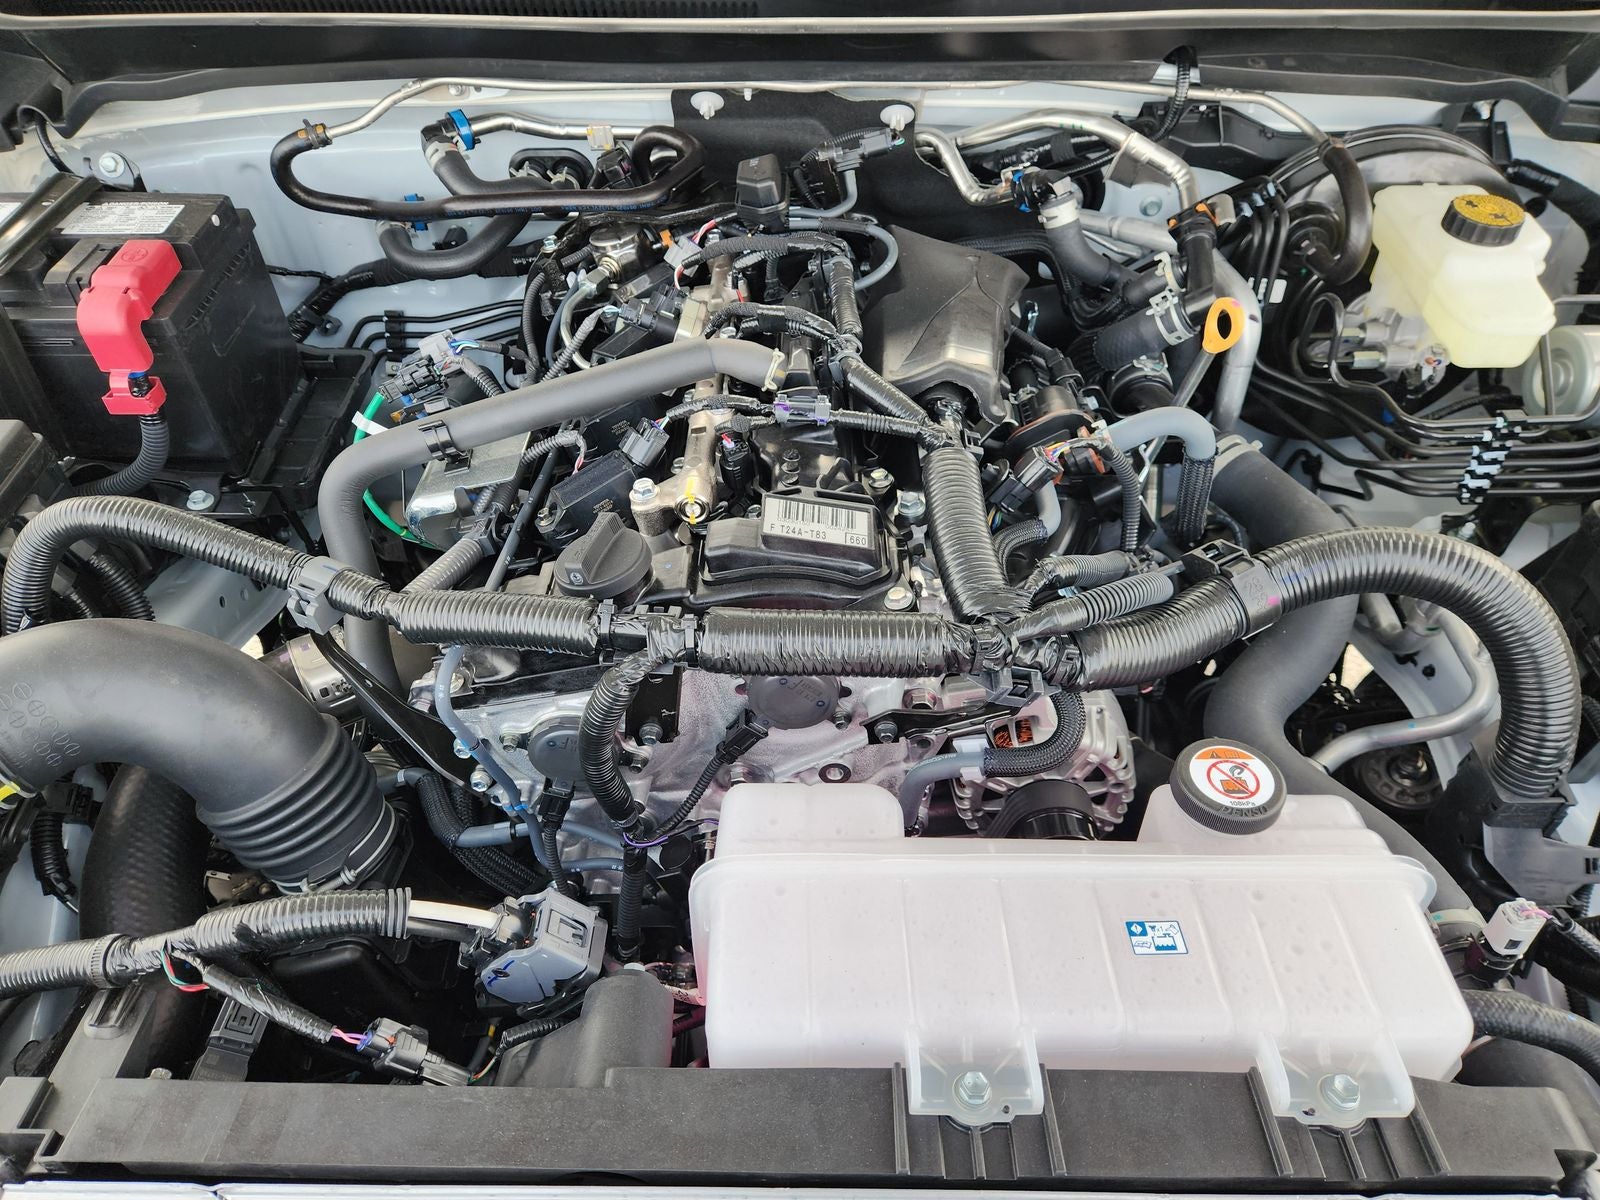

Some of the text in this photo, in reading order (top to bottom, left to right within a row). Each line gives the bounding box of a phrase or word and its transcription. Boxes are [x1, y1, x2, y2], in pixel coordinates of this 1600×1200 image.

[770, 523, 776, 531] F
[780, 524, 827, 540] T24A-T83
[849, 535, 867, 546] 660
